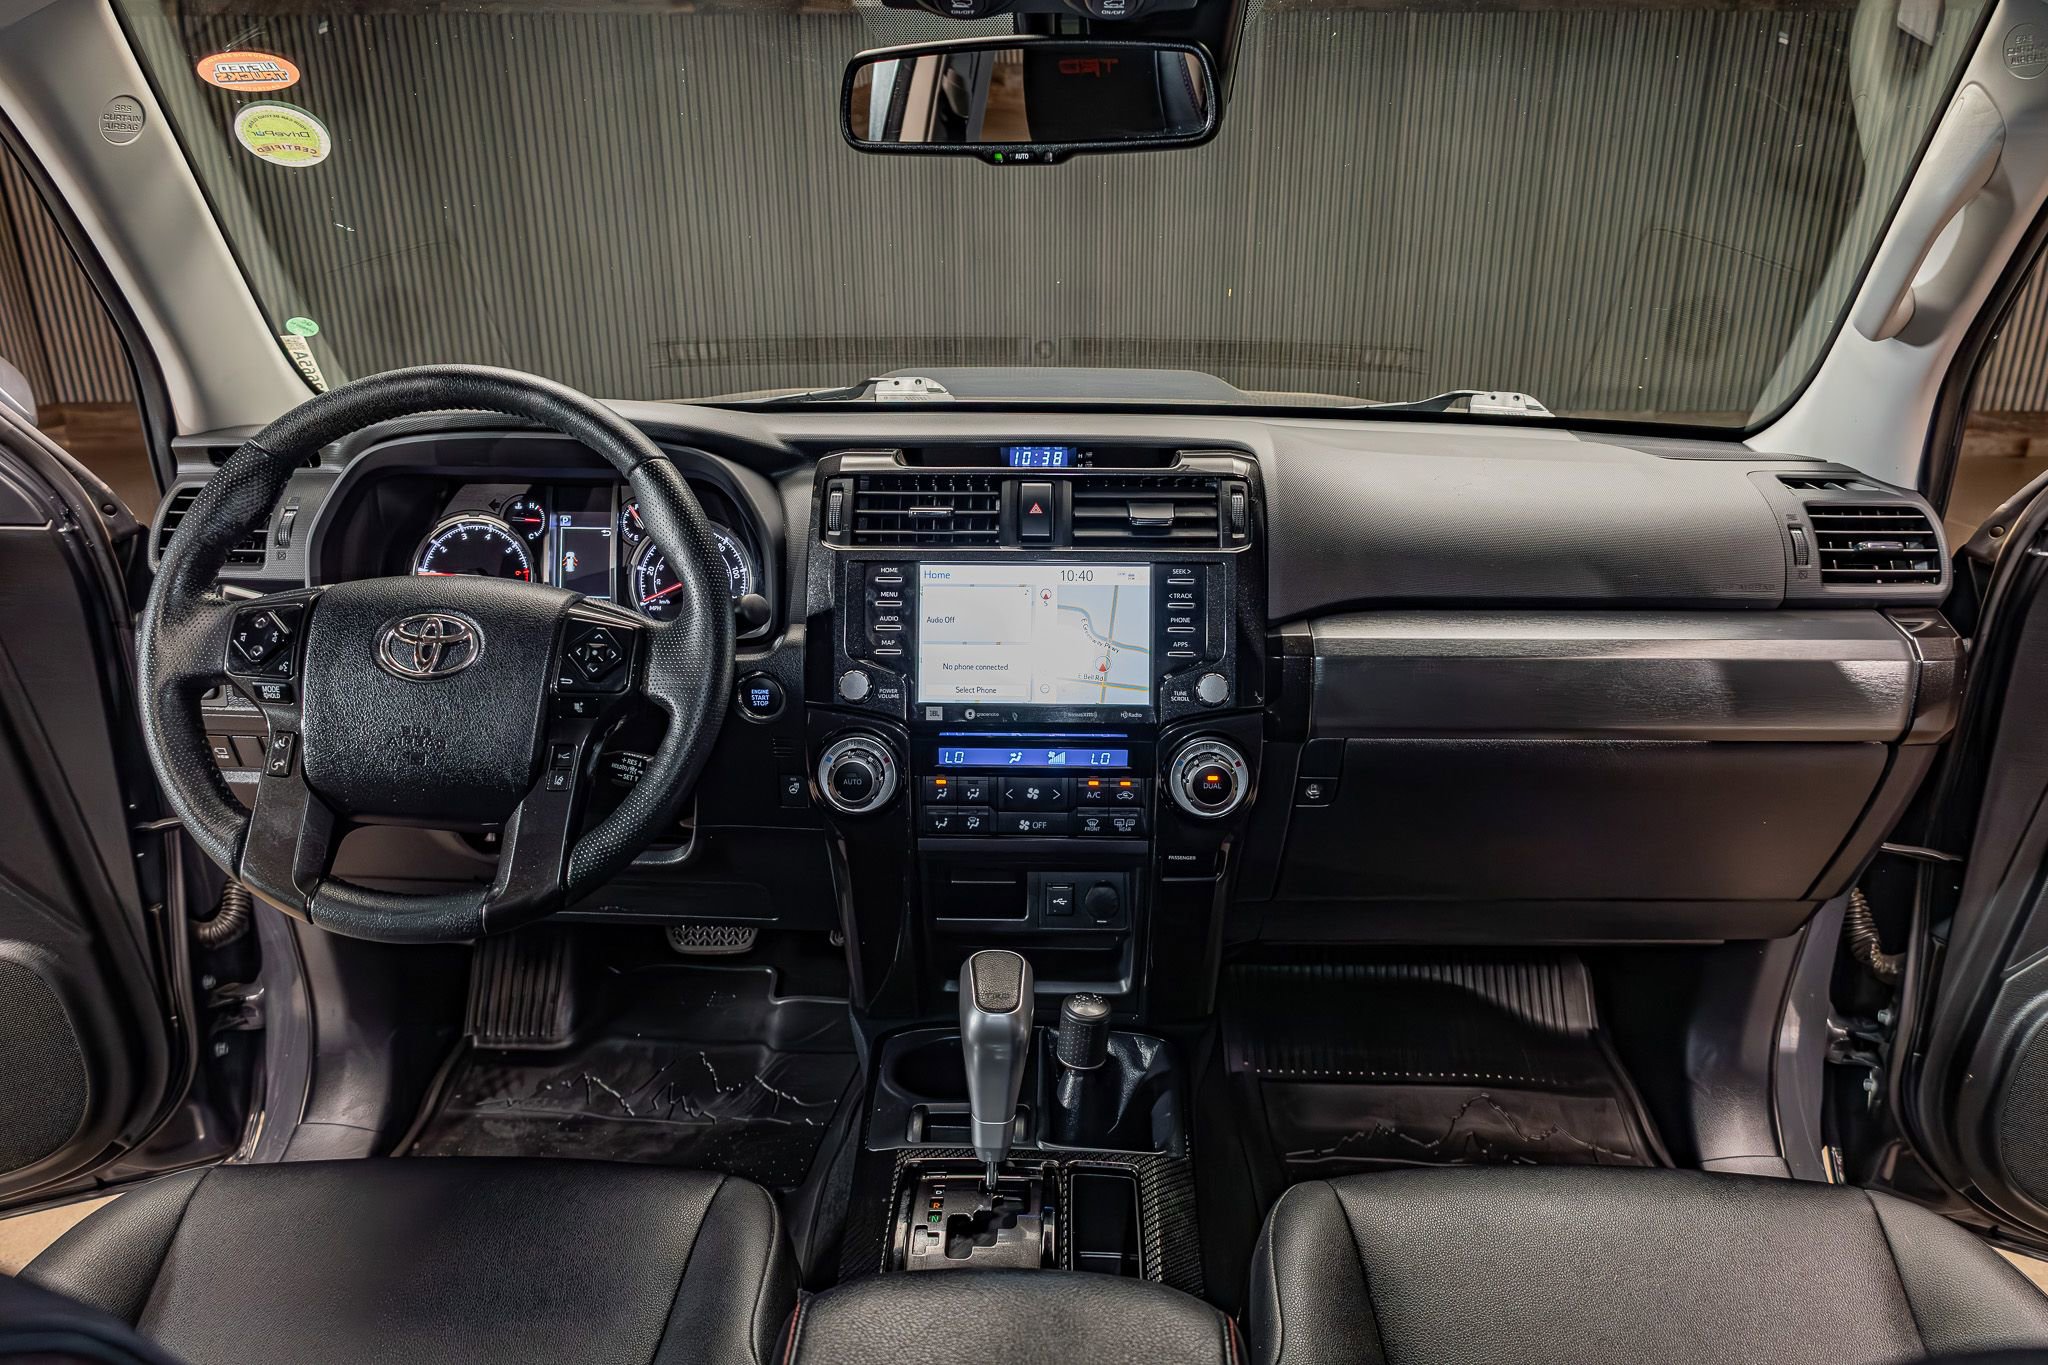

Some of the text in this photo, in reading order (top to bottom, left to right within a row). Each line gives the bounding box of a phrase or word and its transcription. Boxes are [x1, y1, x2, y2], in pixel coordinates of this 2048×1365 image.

[114, 104, 132, 112] SRS
[103, 113, 141, 122] CURTAIN
[103, 122, 139, 131] AIRBAG
[1014, 451, 1063, 465] 10:38
[461, 533, 468, 541] 3
[440, 545, 448, 553] 2
[646, 566, 655, 576] 20
[731, 566, 740, 580] 100
[924, 570, 951, 579] Home
[1060, 569, 1094, 582] 10:40
[954, 663, 974, 671] phone
[975, 663, 1009, 671] connected
[955, 686, 997, 694] Select Phone
[1086, 790, 1101, 799] A/C
[1032, 821, 1048, 829] OFF
[932, 1215, 939, 1223] N
